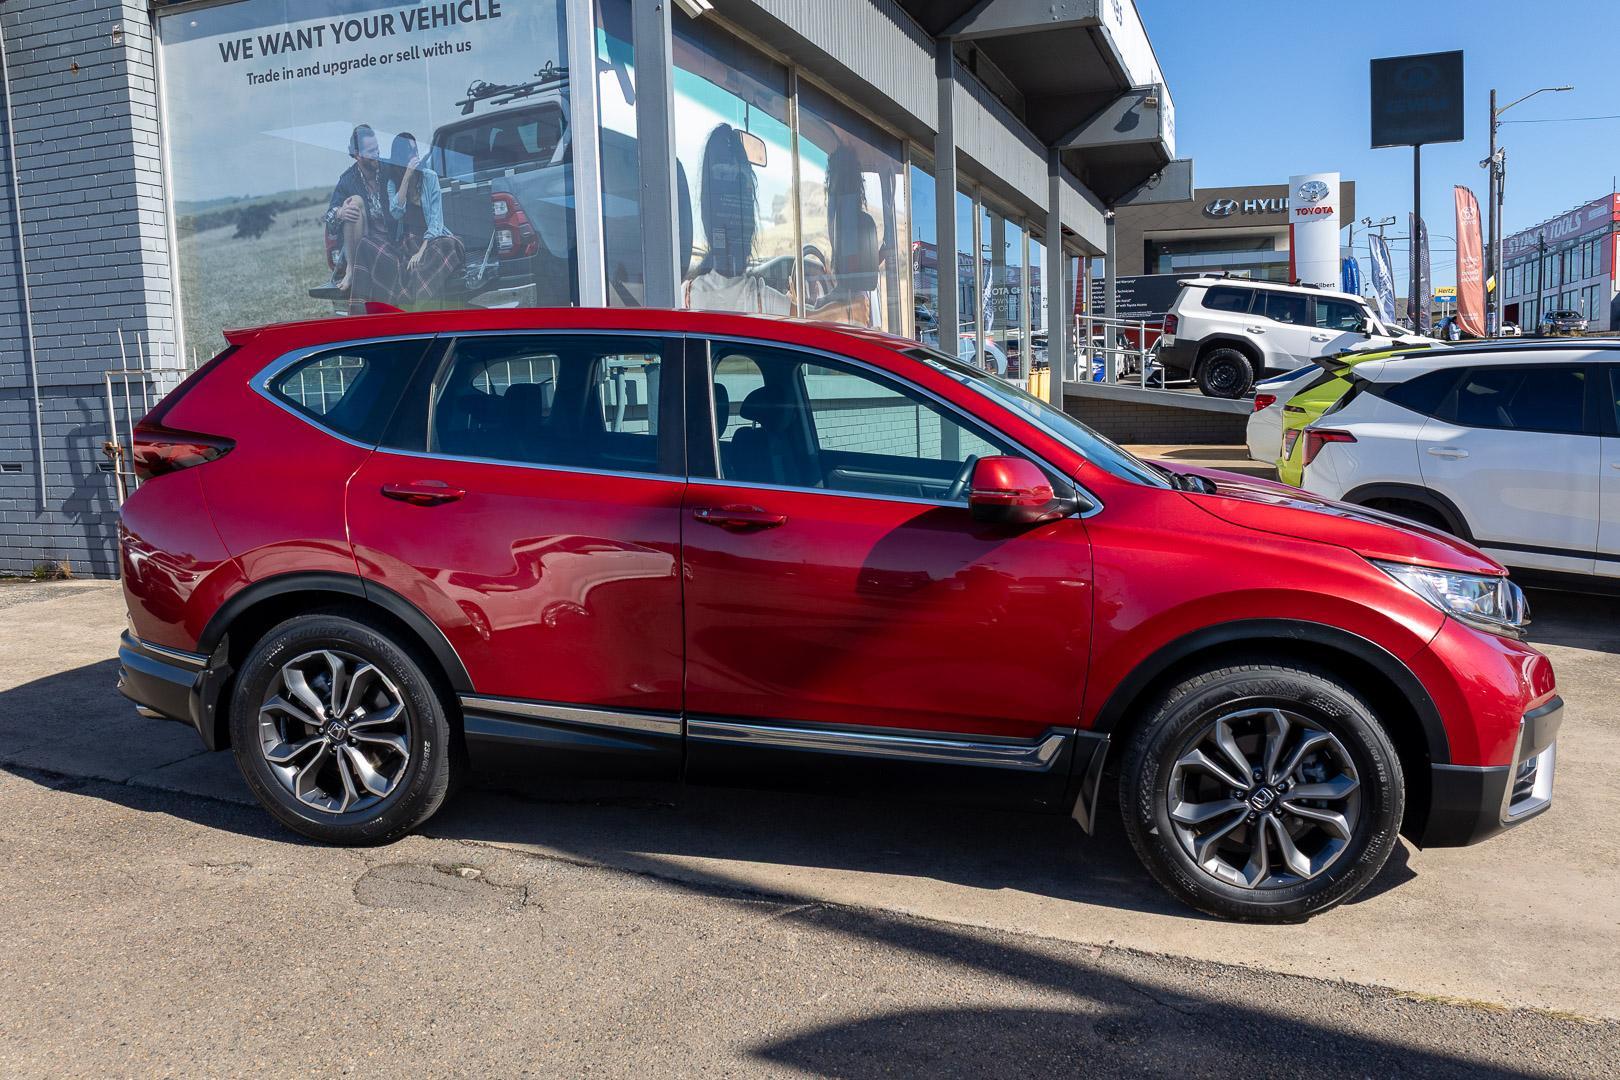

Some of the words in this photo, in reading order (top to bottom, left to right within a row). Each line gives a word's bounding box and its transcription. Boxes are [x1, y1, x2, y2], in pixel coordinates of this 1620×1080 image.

[219, 37, 254, 63] WE
[257, 25, 326, 57] WANT
[330, 13, 396, 45] YOUR
[399, 0, 502, 33] VEHICLE
[246, 68, 280, 86] Trade
[282, 66, 294, 80] in
[296, 61, 320, 78] and
[322, 53, 377, 76] upgrade
[379, 53, 394, 65] or
[396, 45, 420, 63] sell
[422, 40, 453, 58] with
[456, 40, 472, 53] us
[1295, 206, 1334, 216] TOYOTA
[1550, 211, 1583, 241] TOOLS
[1358, 730, 1381, 761] 235/60
[1376, 763, 1388, 783] R18
